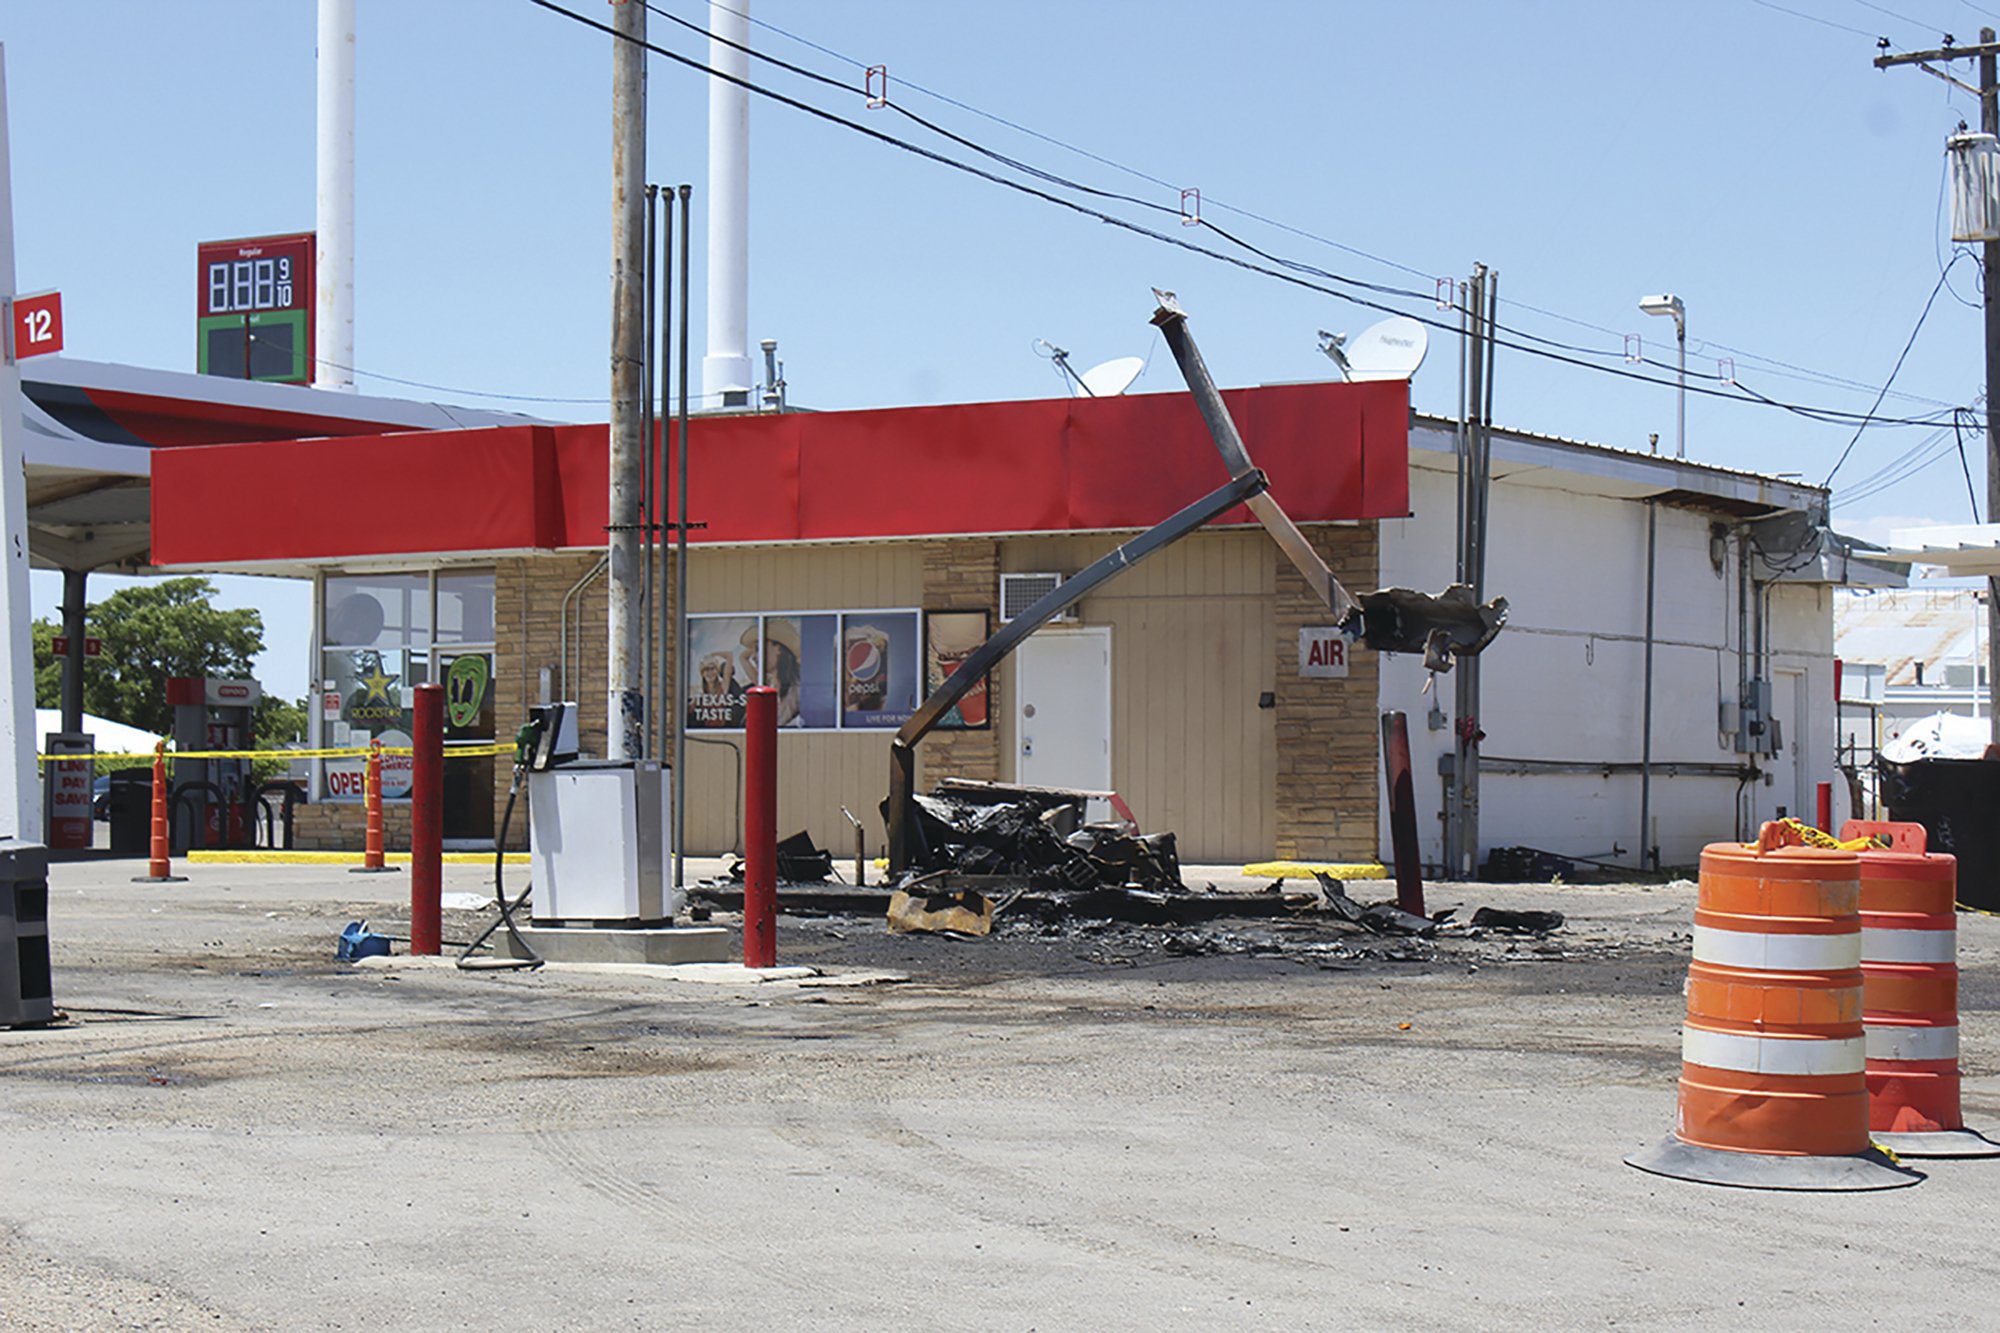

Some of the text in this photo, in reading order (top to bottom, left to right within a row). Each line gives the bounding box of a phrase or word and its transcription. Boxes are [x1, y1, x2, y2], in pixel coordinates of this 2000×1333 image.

[24, 309, 53, 343] 12
[1308, 639, 1345, 666] AIR
[848, 683, 881, 695] pepsi
[694, 693, 748, 706] TEXAS-S
[694, 708, 733, 721] TASTE
[865, 714, 880, 723] LIVE
[380, 760, 413, 771] AMERIC
[62, 777, 87, 788] PAY
[55, 792, 89, 806] SAVE
